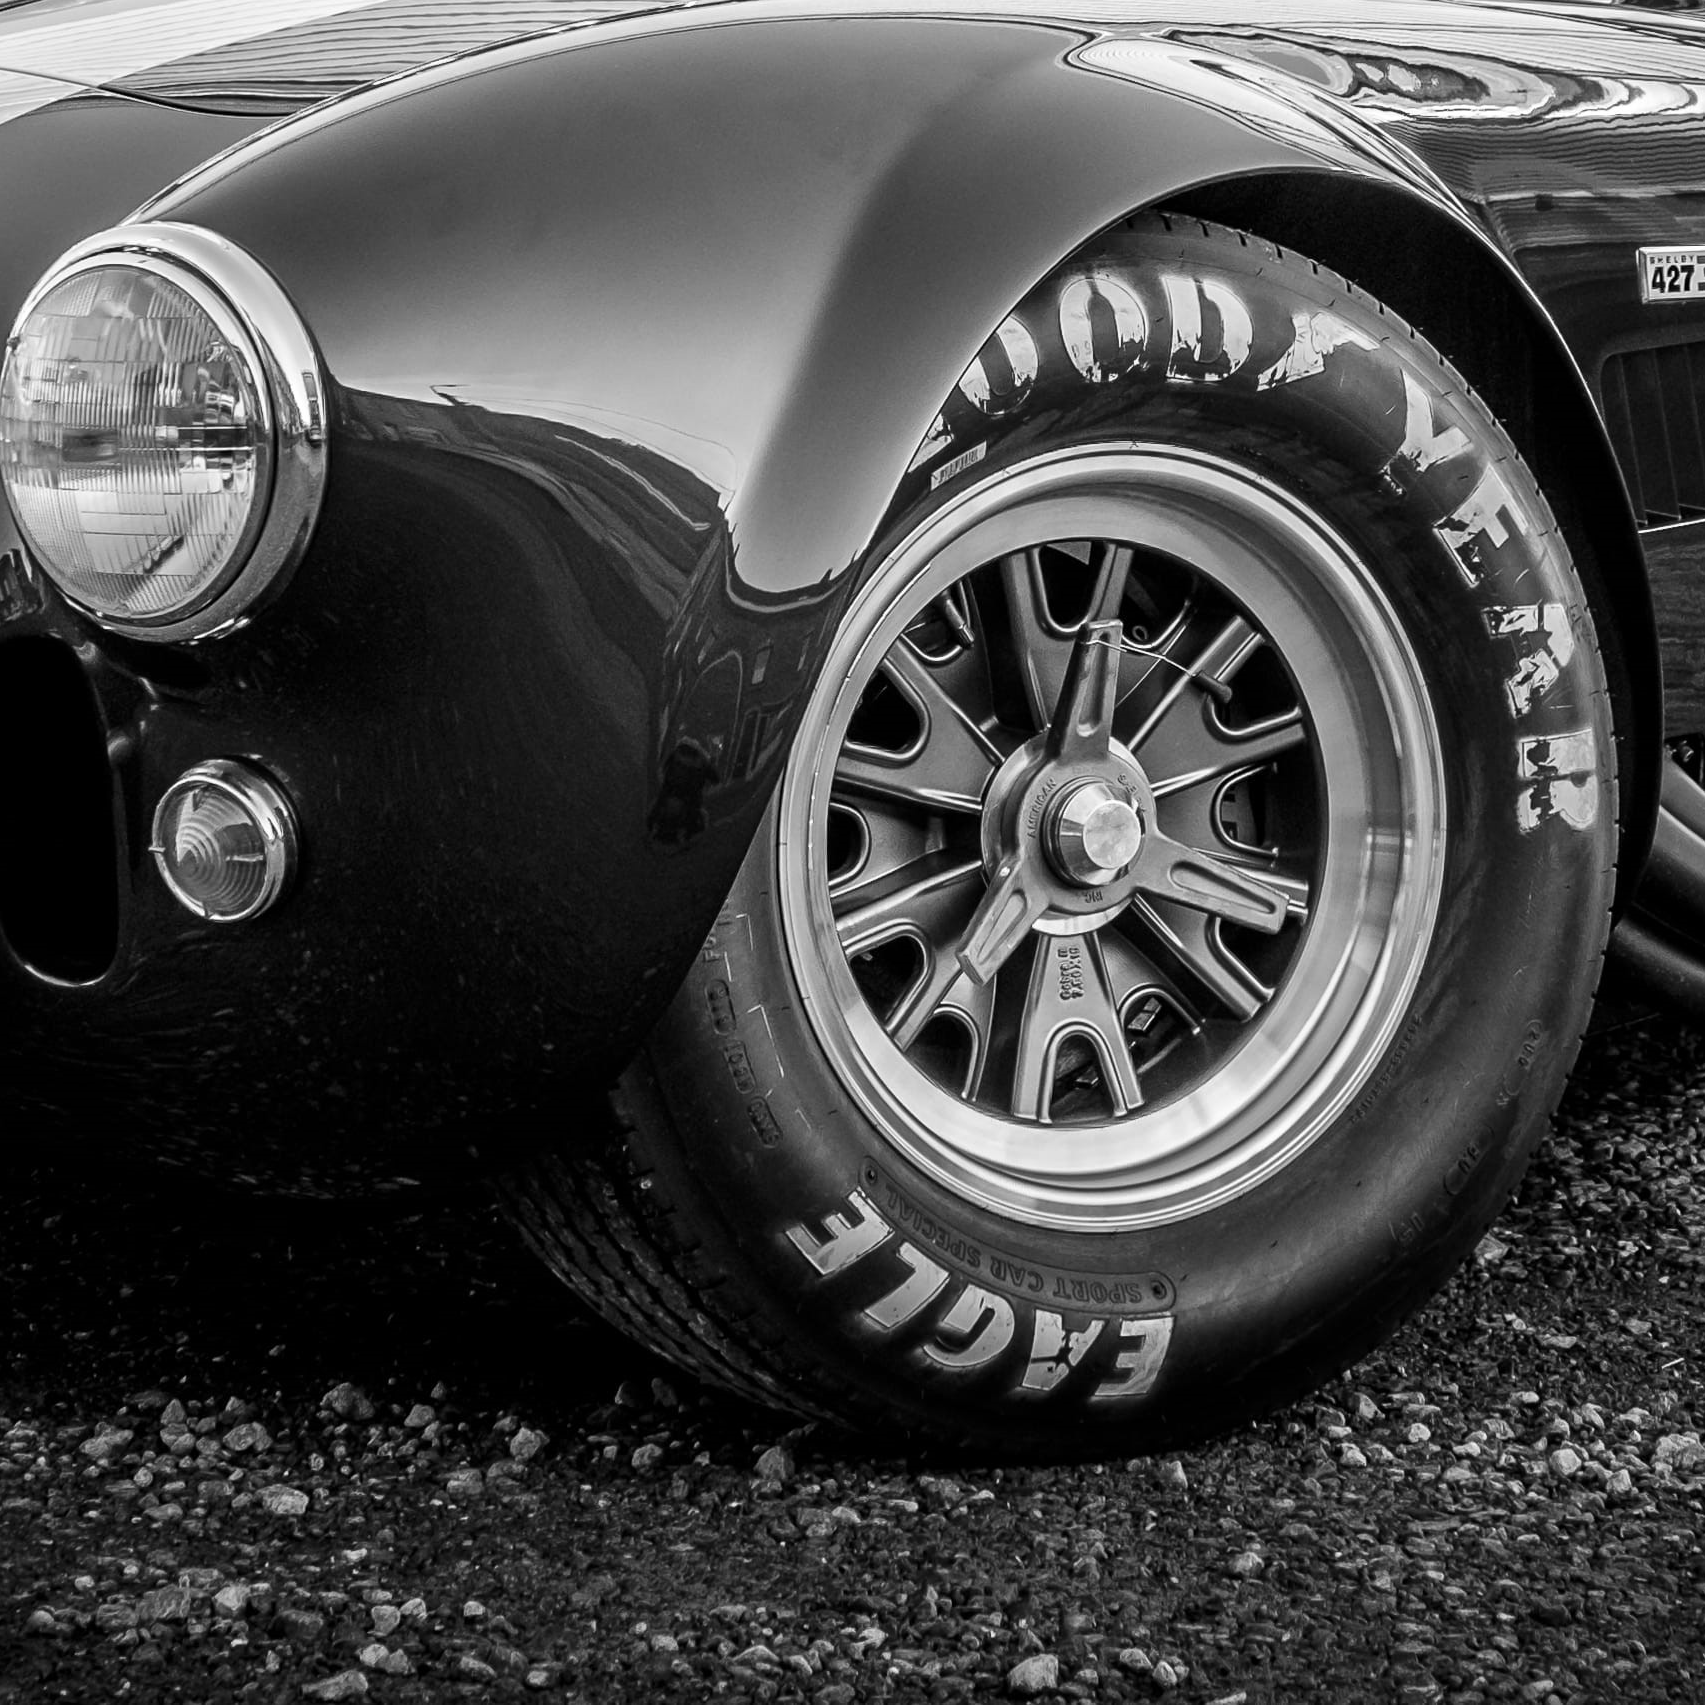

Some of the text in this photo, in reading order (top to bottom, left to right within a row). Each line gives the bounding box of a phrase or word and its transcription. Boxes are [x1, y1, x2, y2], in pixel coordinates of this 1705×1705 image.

[1649, 254, 1695, 265] SHELBY
[1651, 264, 1695, 294] 427
[885, 1185, 1143, 1305] SPORT CAR SPECIAL
[786, 1186, 1176, 1400] EAGLE
